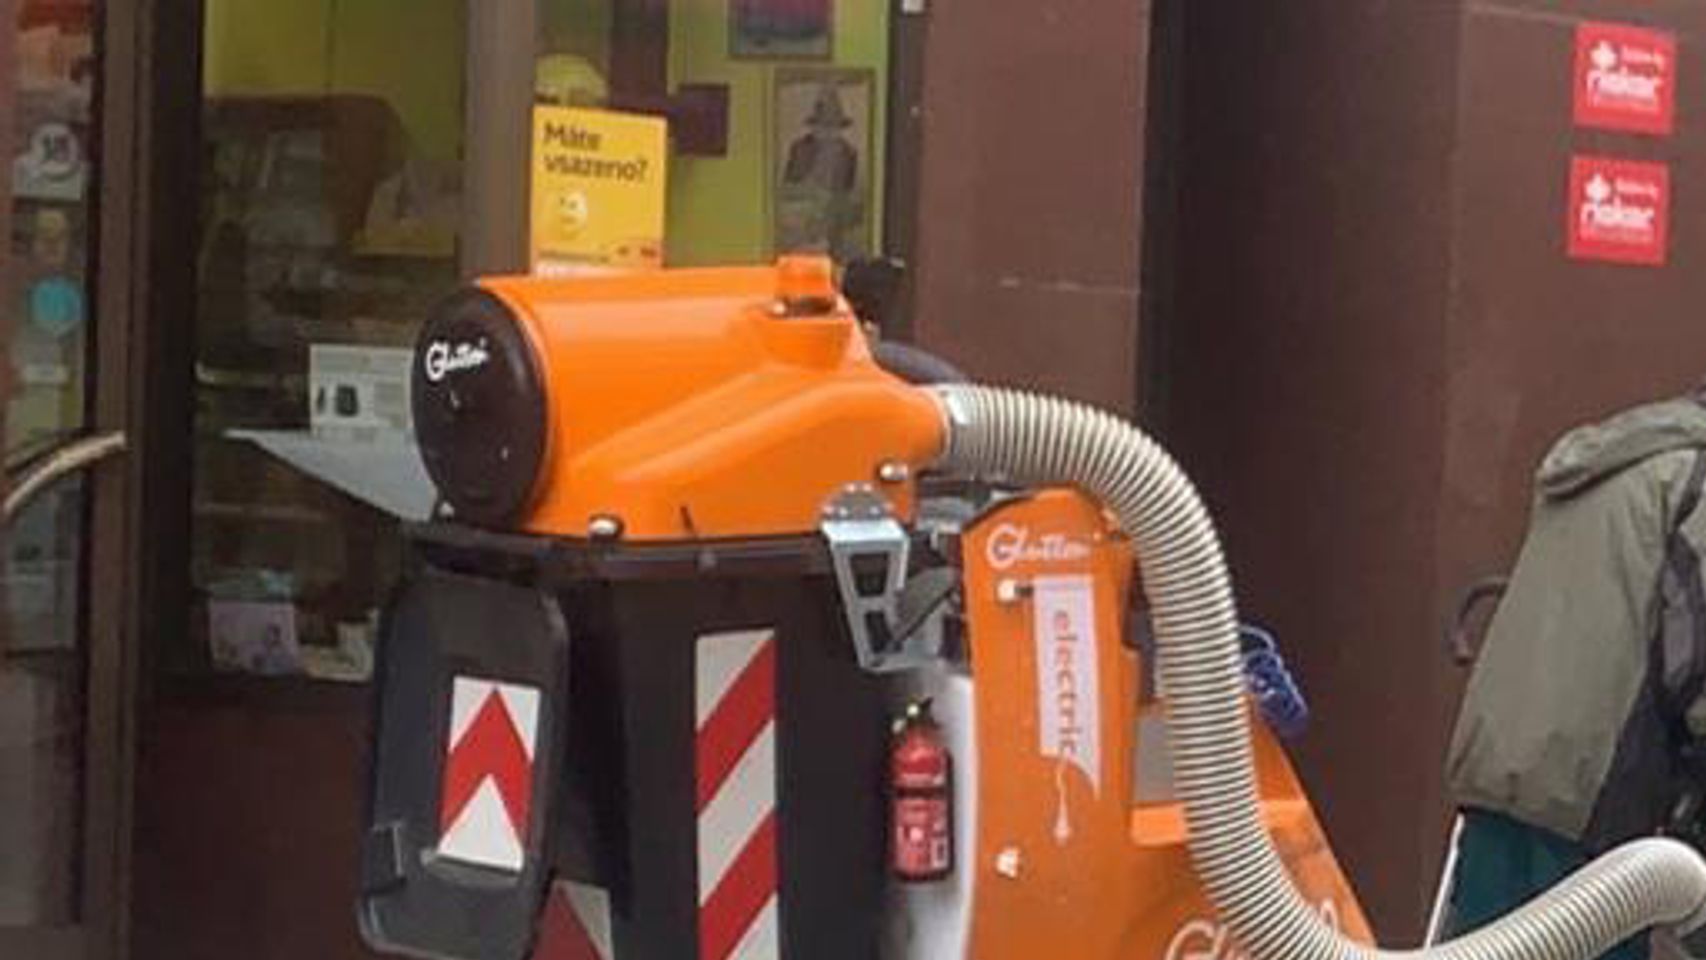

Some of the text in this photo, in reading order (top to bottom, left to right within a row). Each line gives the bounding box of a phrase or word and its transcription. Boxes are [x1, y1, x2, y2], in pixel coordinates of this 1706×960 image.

[542, 122, 602, 151] Máte
[544, 153, 650, 182] vsazeno?
[986, 523, 1092, 569] Glutton
[1054, 610, 1082, 757] electric
